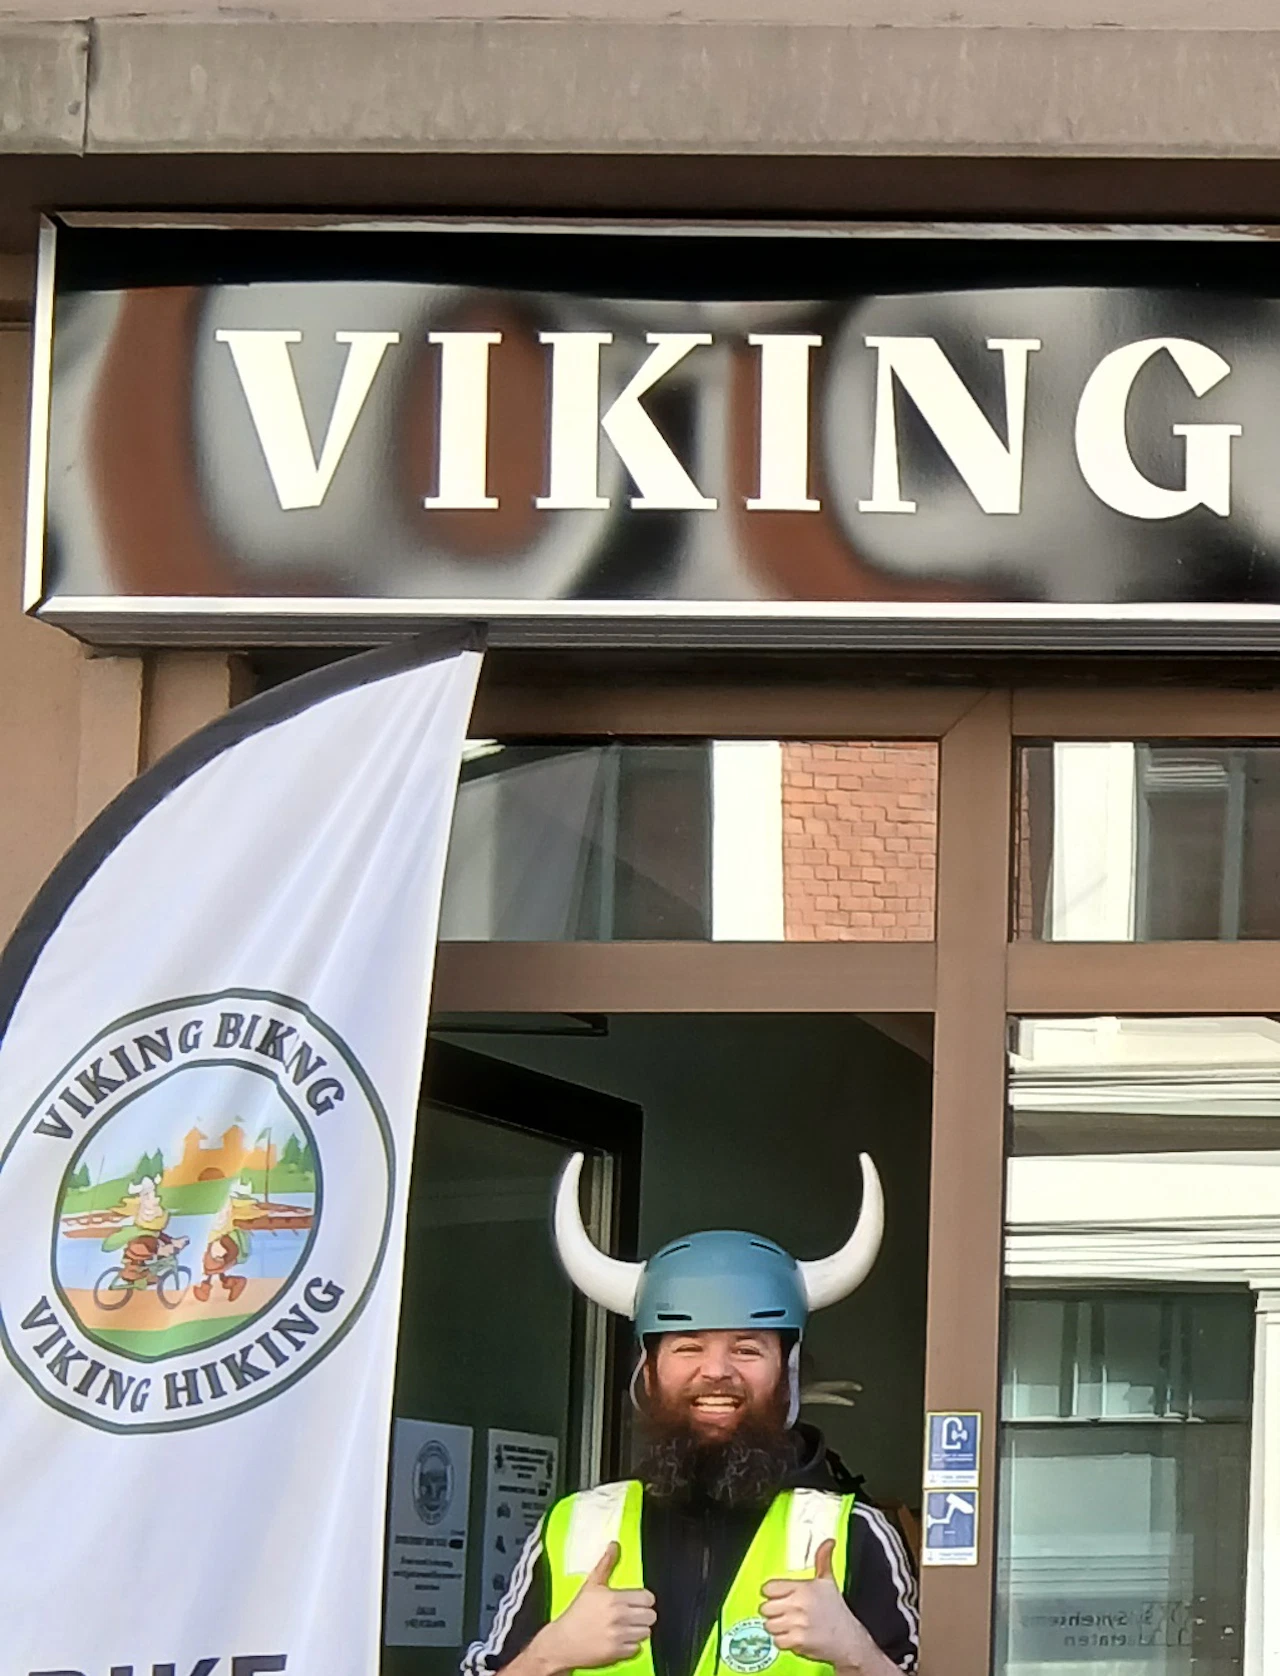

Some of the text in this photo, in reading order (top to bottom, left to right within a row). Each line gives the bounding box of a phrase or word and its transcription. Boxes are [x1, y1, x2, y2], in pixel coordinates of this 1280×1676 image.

[217, 331, 1241, 520] VIKING
[33, 1012, 345, 1143] VIKING BIKNG
[20, 1276, 345, 1413] VIKING HIKING
